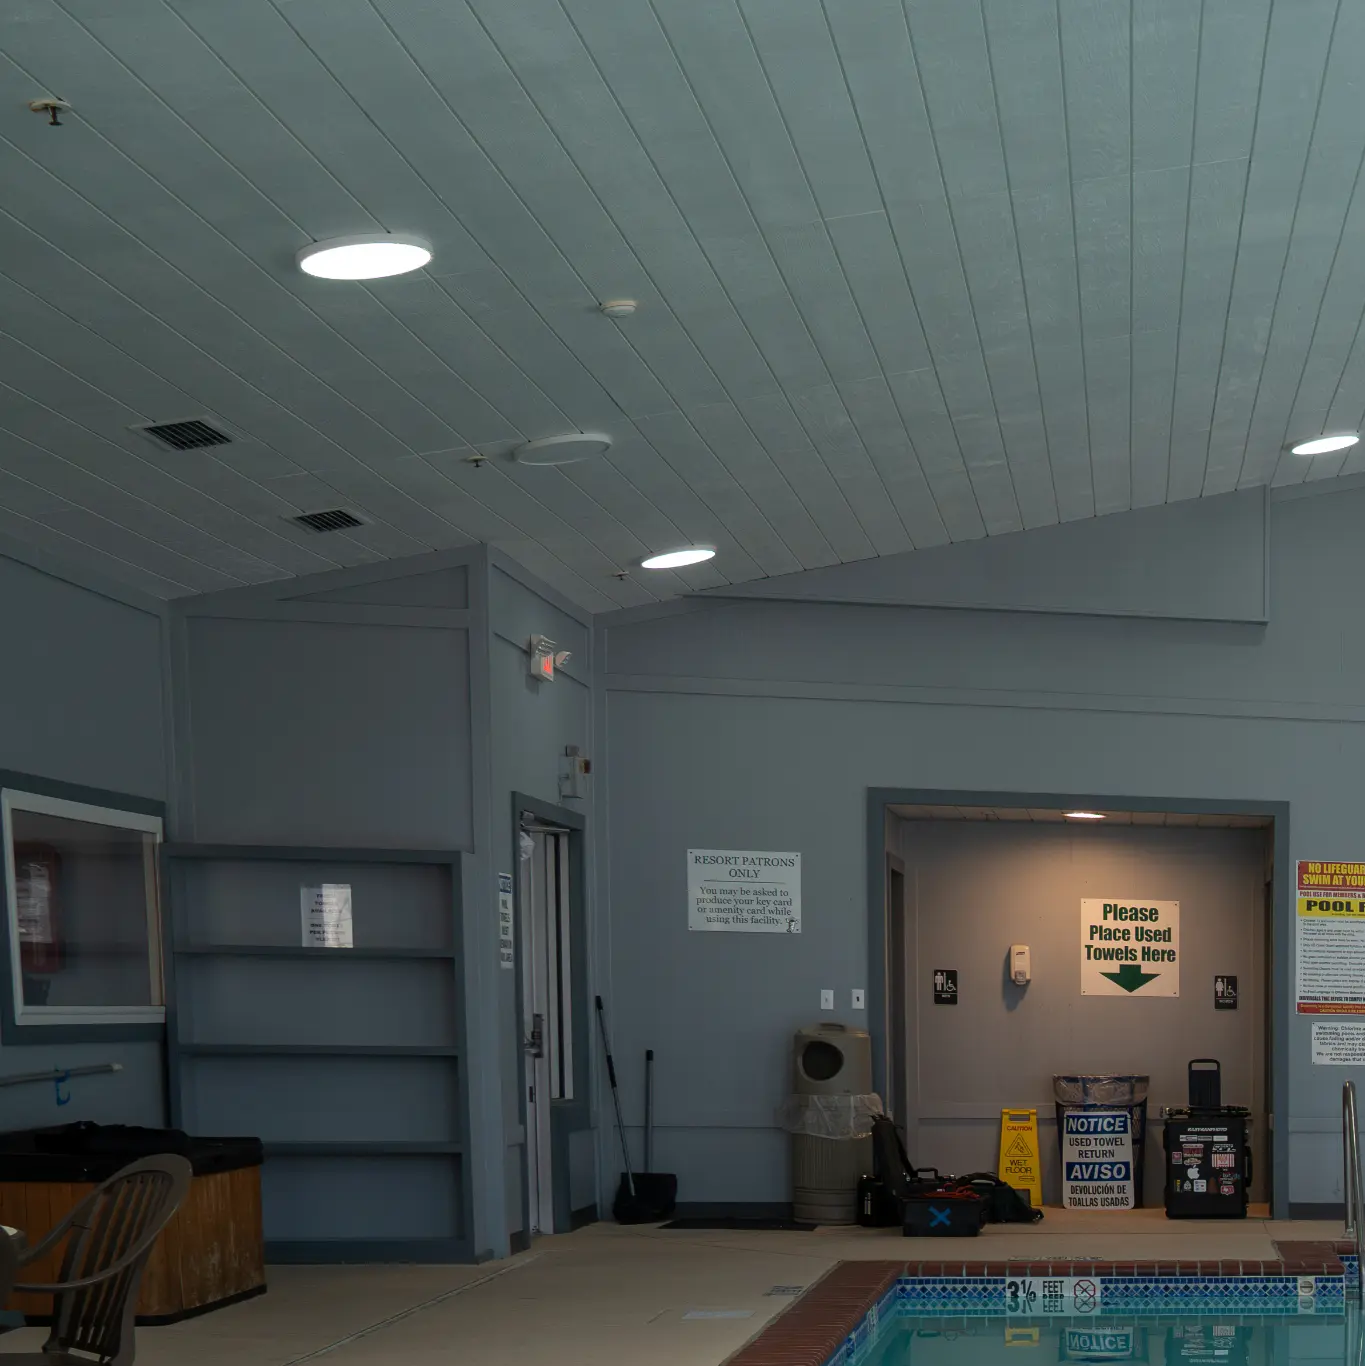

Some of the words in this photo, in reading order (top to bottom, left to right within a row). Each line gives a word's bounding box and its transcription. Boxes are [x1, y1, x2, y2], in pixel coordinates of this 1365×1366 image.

[694, 855, 740, 865] RESORT
[742, 856, 795, 867] PATRONS
[729, 868, 761, 878] ONLY
[1309, 863, 1321, 873] NO
[1303, 874, 1330, 885] SWIM
[1333, 875, 1343, 885] AT
[700, 886, 717, 895] You
[719, 888, 737, 896] may
[740, 887, 751, 895] be
[753, 888, 778, 897] asked
[780, 889, 789, 897] to
[696, 896, 732, 905] produce
[733, 898, 754, 906] your
[756, 897, 771, 907] key
[773, 898, 792, 906] card
[1306, 900, 1354, 912] POOL
[697, 906, 706, 914] or
[709, 905, 744, 915] amenity
[747, 907, 765, 915] card
[768, 907, 792, 916] while
[1103, 903, 1159, 922] Please
[706, 915, 730, 925] using
[732, 915, 749, 924] this
[751, 915, 782, 927] facility.
[1090, 925, 1130, 941] Place
[1135, 926, 1171, 942] Used
[1085, 945, 1138, 961] Towels
[1141, 946, 1176, 962] Here
[1068, 1118, 1125, 1132] NOTICE
[1069, 1138, 1091, 1147] USED
[1094, 1137, 1125, 1147] TOWEL
[1078, 1149, 1115, 1159] RETURN
[1070, 1164, 1126, 1179] AVISO
[1070, 1183, 1115, 1195] DEVOLUCIÓN
[1117, 1185, 1127, 1194] DE
[1068, 1197, 1098, 1207] TOALLAS
[1101, 1196, 1129, 1207] USADAS
[1042, 1280, 1065, 1294] FEET
